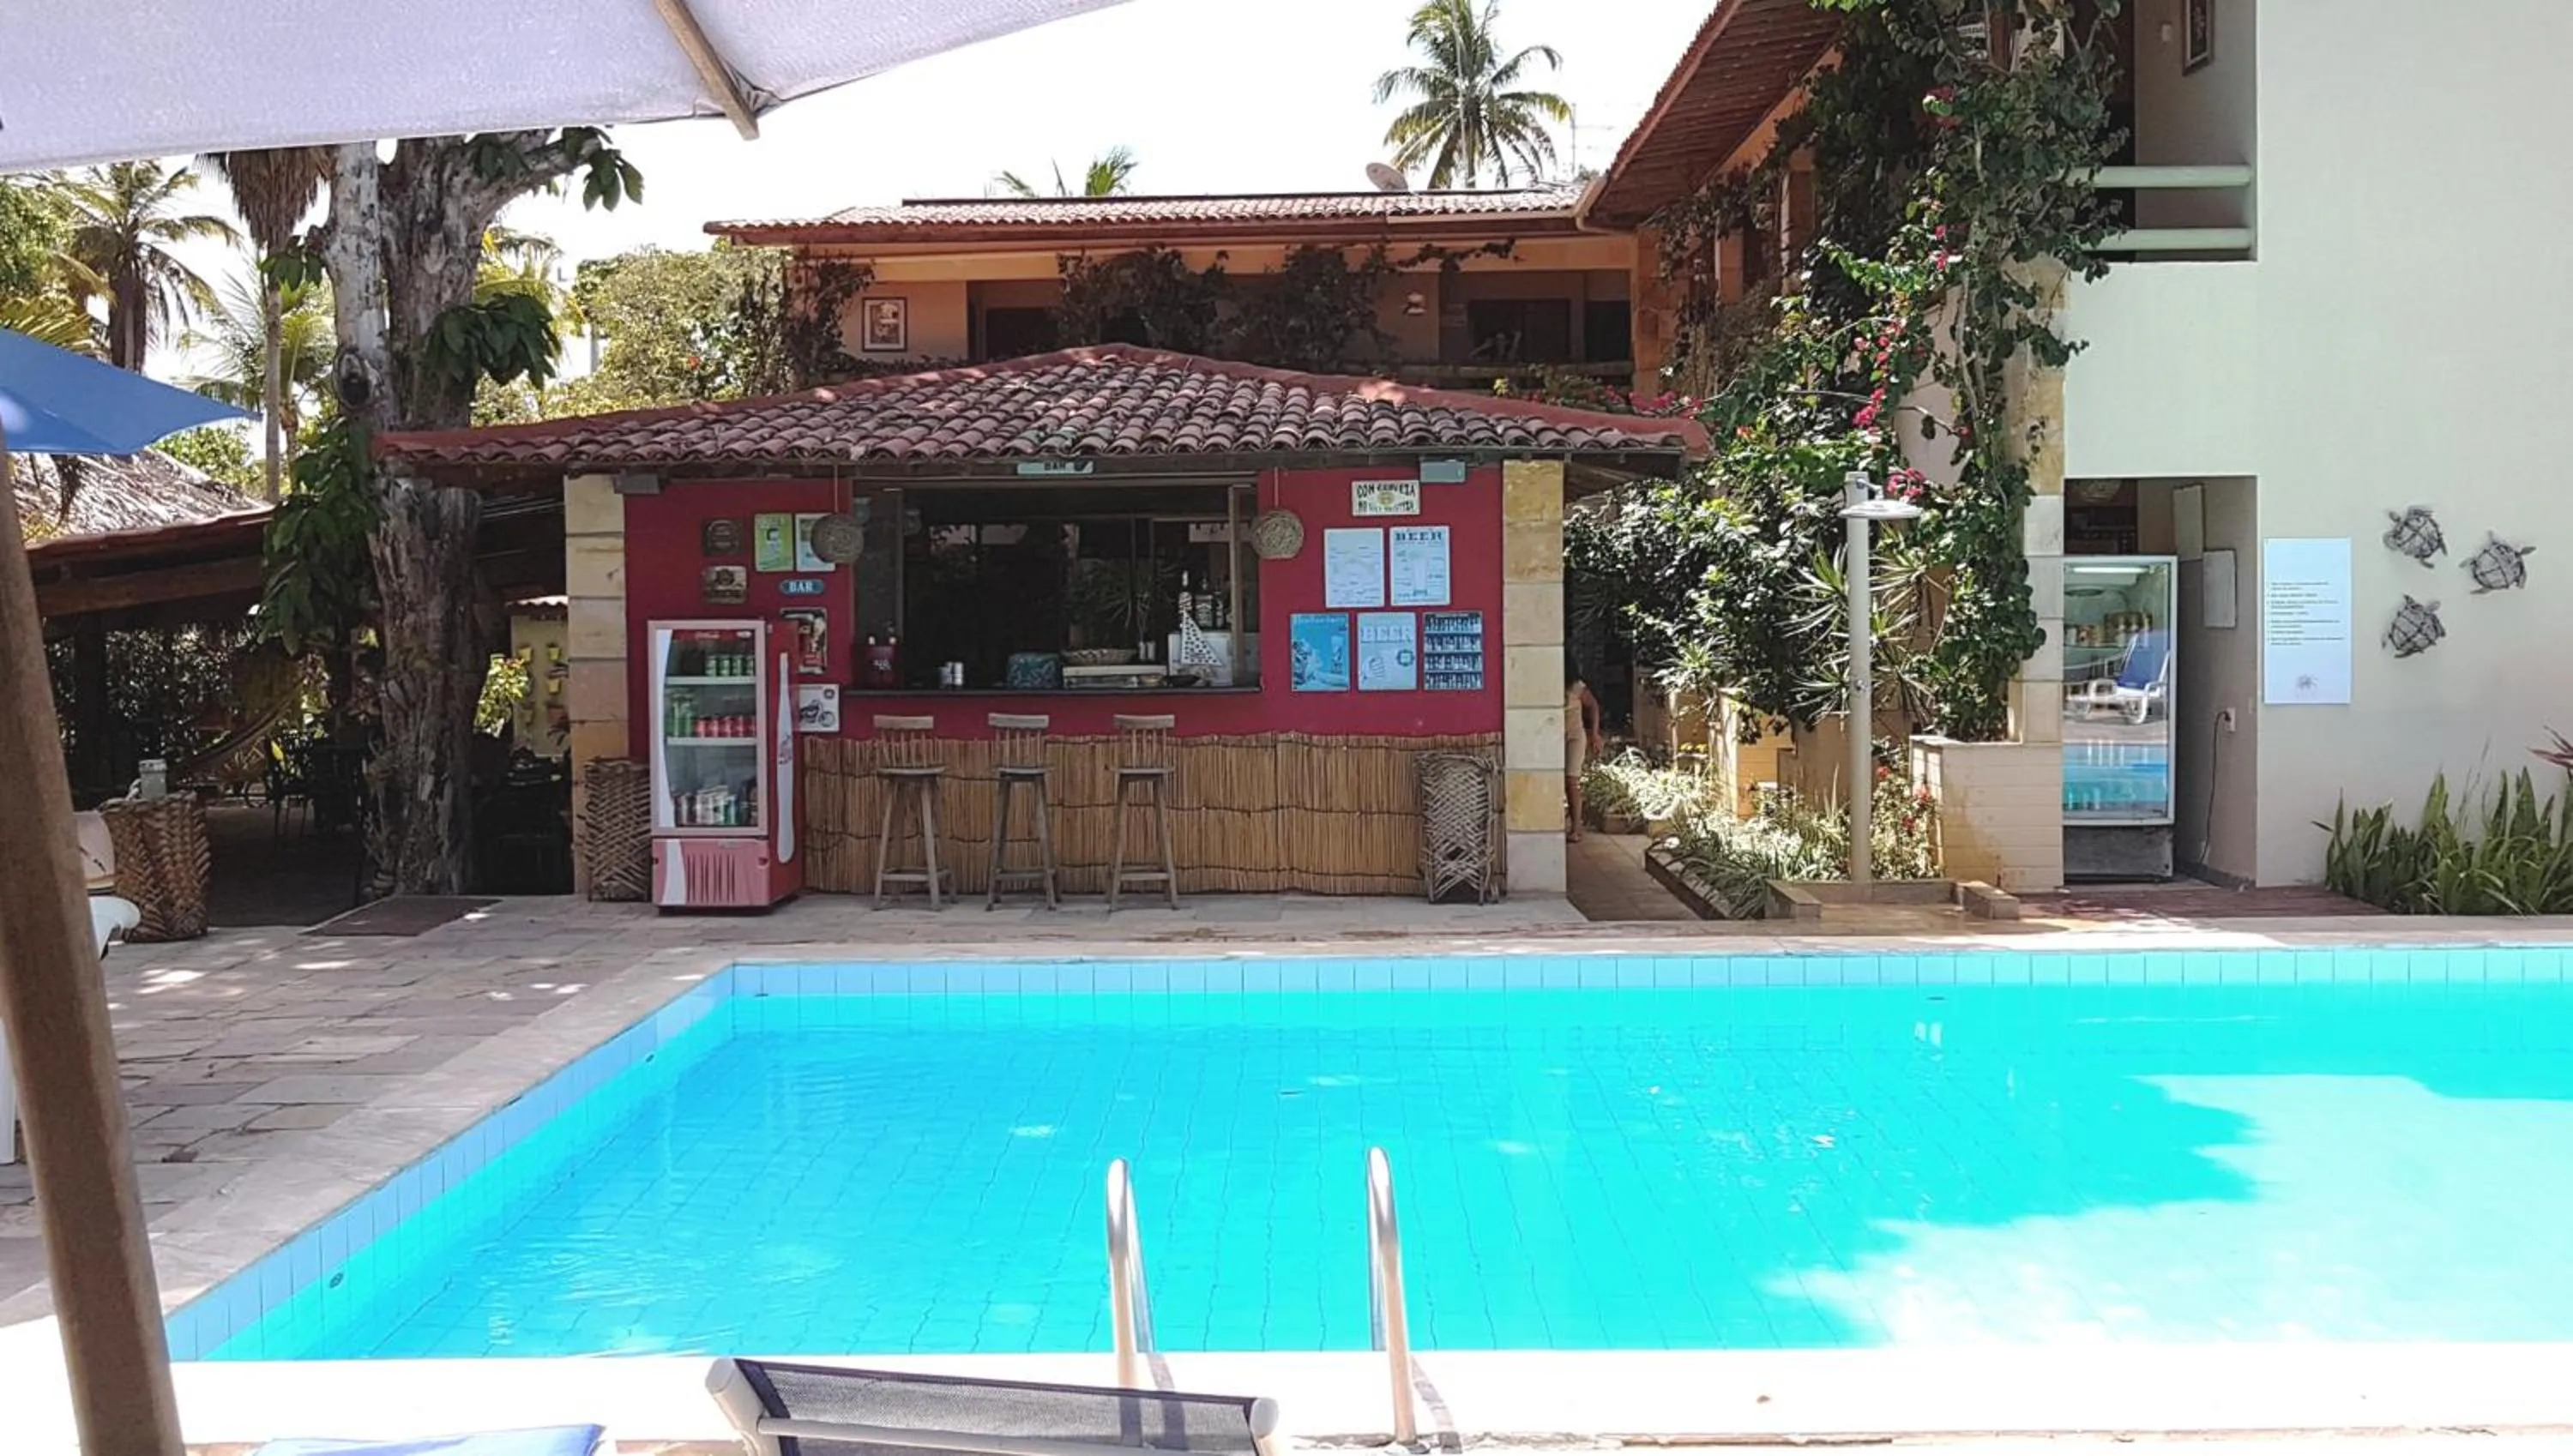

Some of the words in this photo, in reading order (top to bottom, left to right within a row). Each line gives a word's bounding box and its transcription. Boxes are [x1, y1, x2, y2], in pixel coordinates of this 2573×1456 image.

[1044, 460, 1066, 472] BAR
[1395, 531, 1443, 541] BEER
[788, 581, 814, 593] BAR
[1361, 625, 1412, 642] BEER
